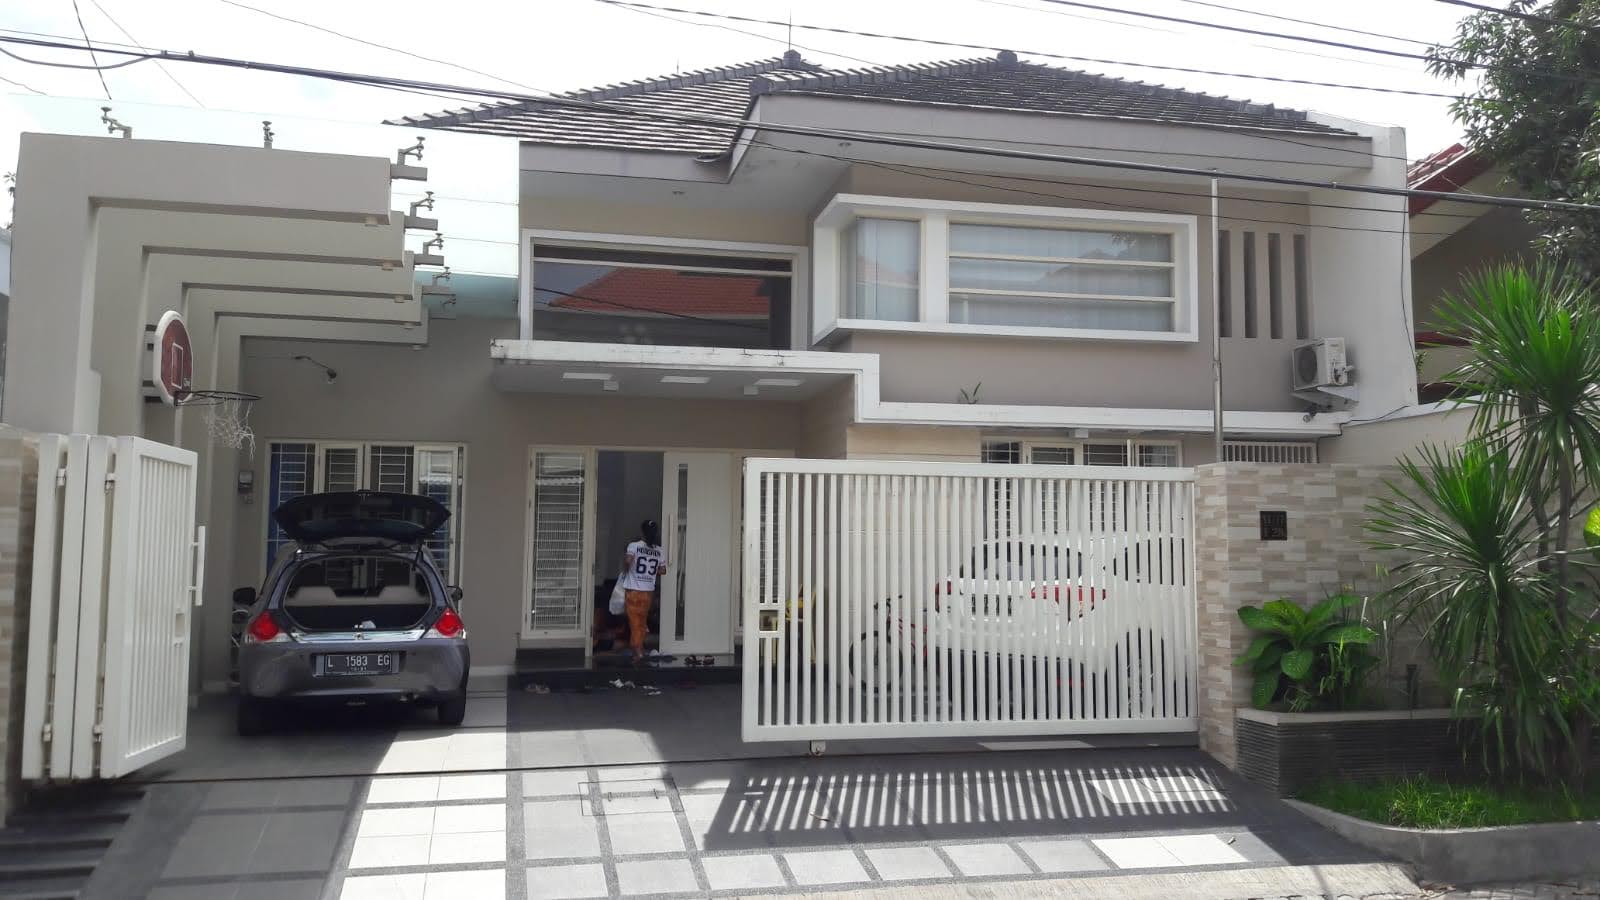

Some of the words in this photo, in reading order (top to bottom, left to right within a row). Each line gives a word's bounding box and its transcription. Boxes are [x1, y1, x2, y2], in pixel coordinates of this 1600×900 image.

[636, 556, 659, 576] 63
[327, 655, 334, 668] L
[345, 655, 368, 667] 1583
[377, 654, 390, 666] EG
